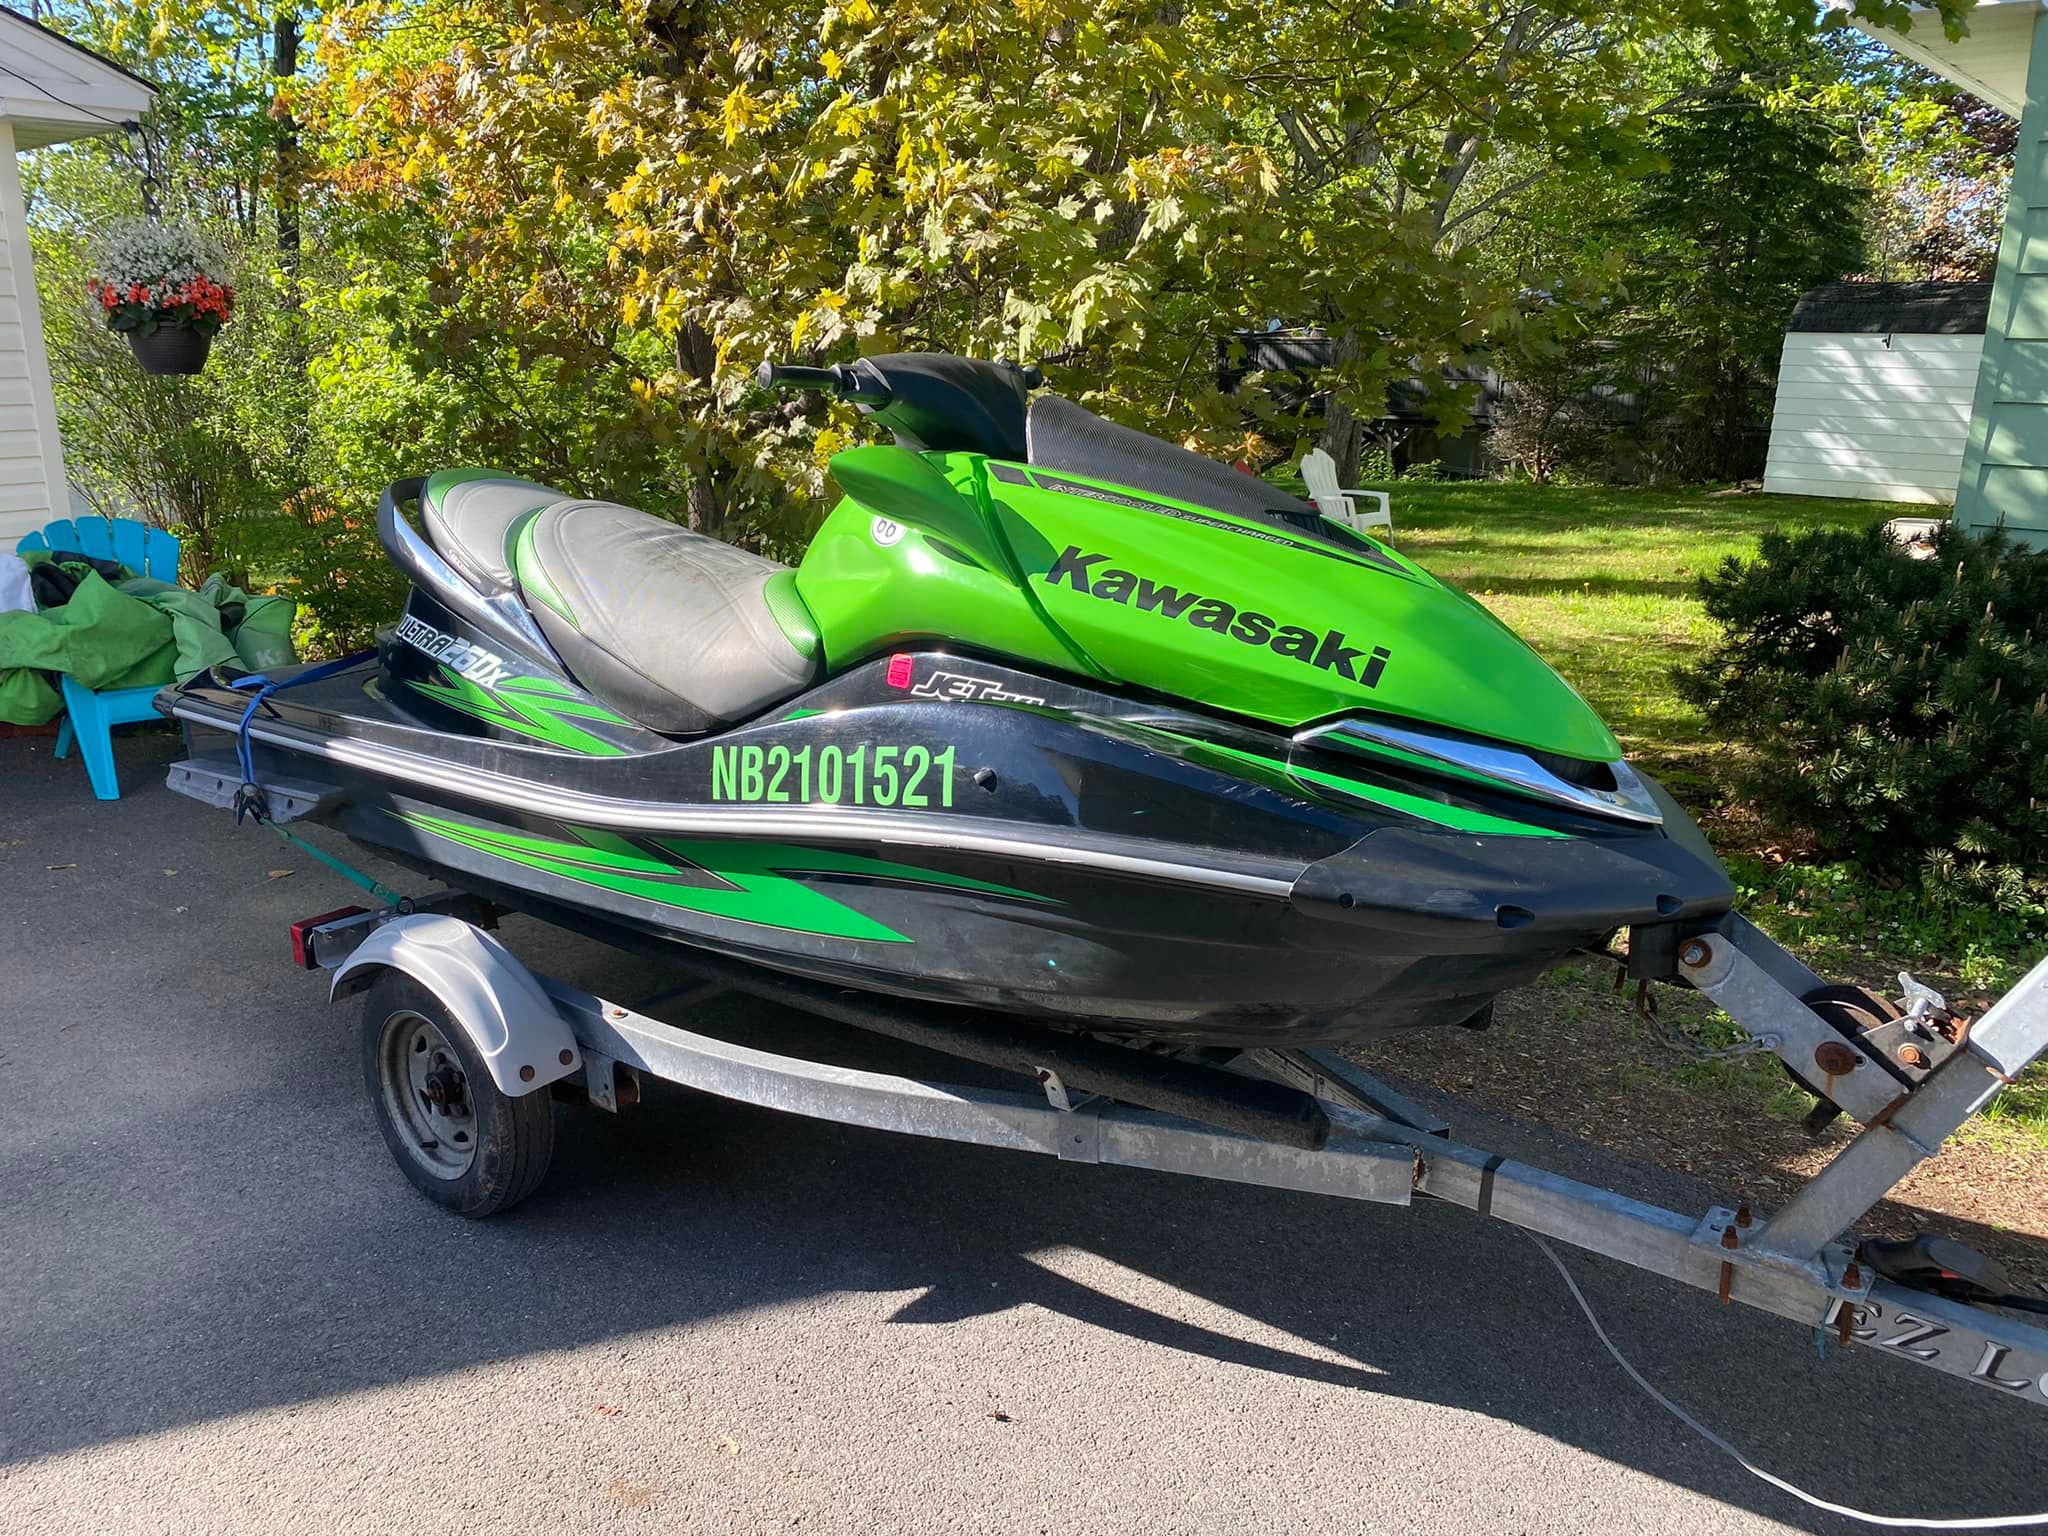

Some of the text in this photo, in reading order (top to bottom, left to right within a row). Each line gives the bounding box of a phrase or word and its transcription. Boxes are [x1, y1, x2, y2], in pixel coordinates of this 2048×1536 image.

[1180, 514, 1294, 547] SUPERCHARGED
[396, 614, 455, 657] ULTRA
[1045, 545, 1392, 689] Kawasaki
[712, 745, 956, 807] NB2101521
[1824, 1296, 2048, 1400] EZ L
